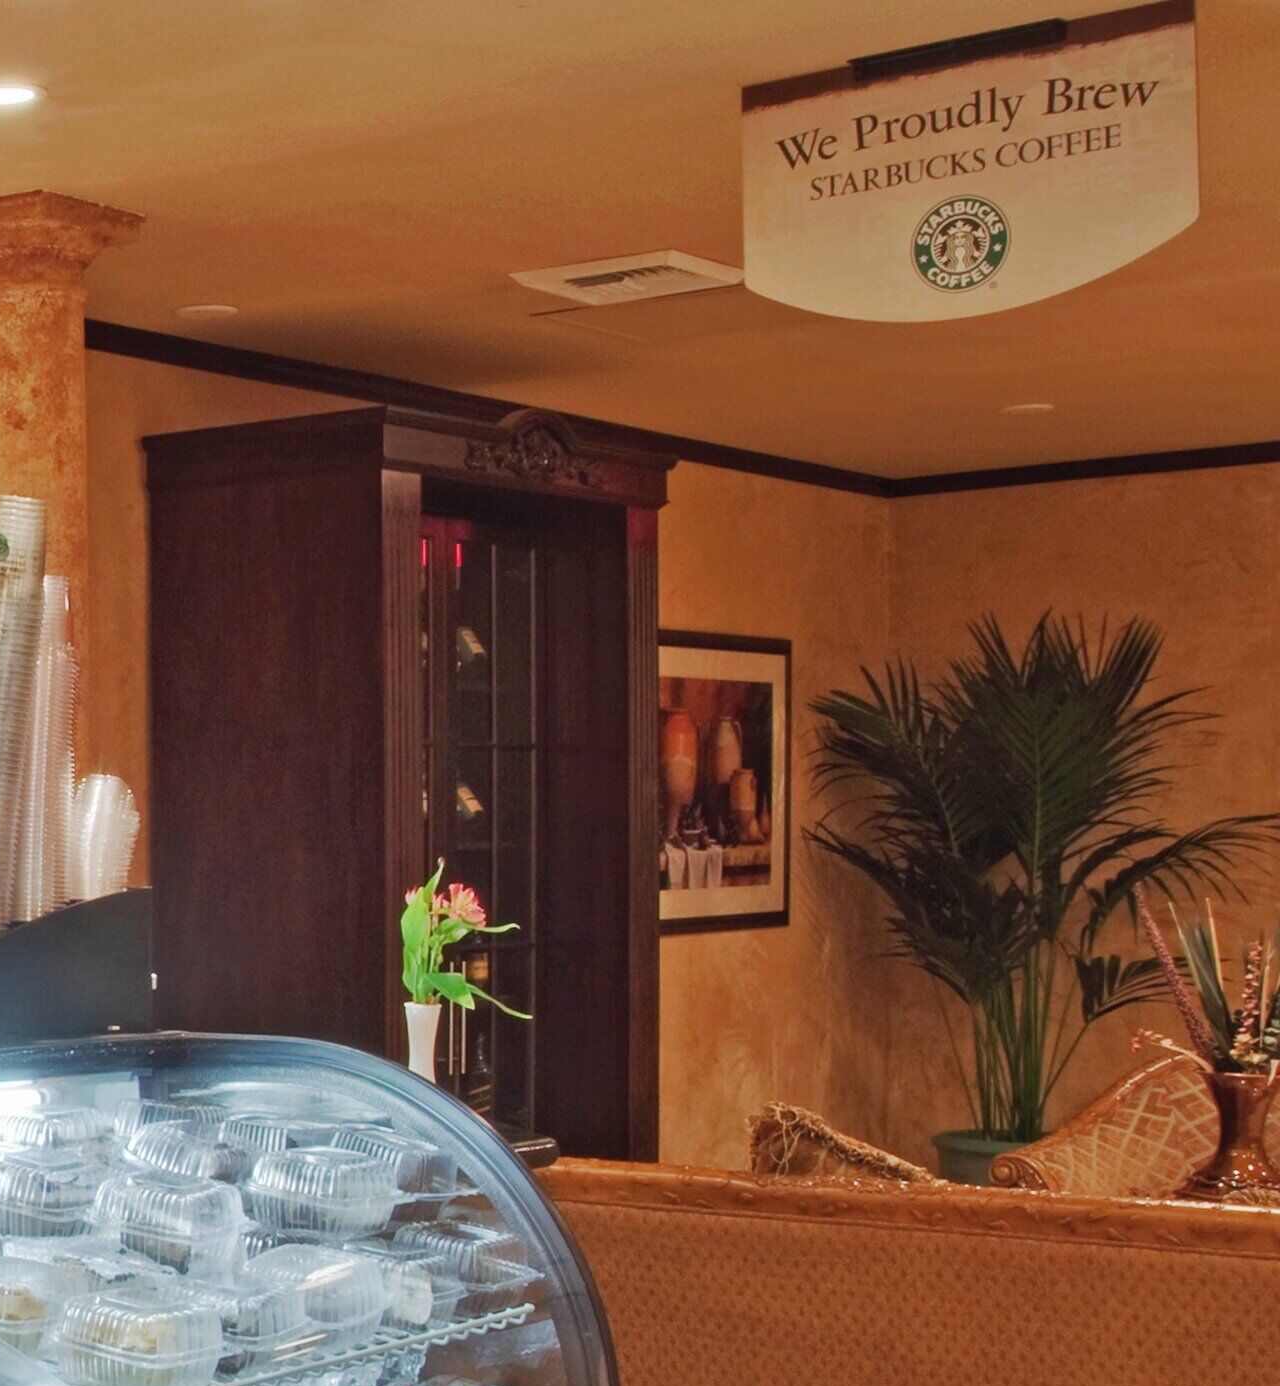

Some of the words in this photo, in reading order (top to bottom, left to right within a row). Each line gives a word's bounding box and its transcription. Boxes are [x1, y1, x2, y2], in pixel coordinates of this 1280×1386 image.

[776, 128, 838, 170] We
[851, 87, 1025, 152] Proudly
[1042, 77, 1160, 116] Brew
[810, 147, 986, 201] STARBUCKS
[995, 124, 1122, 168] COFFEE
[917, 200, 1004, 246] STARBUCKS
[927, 261, 993, 288] COFFEE
